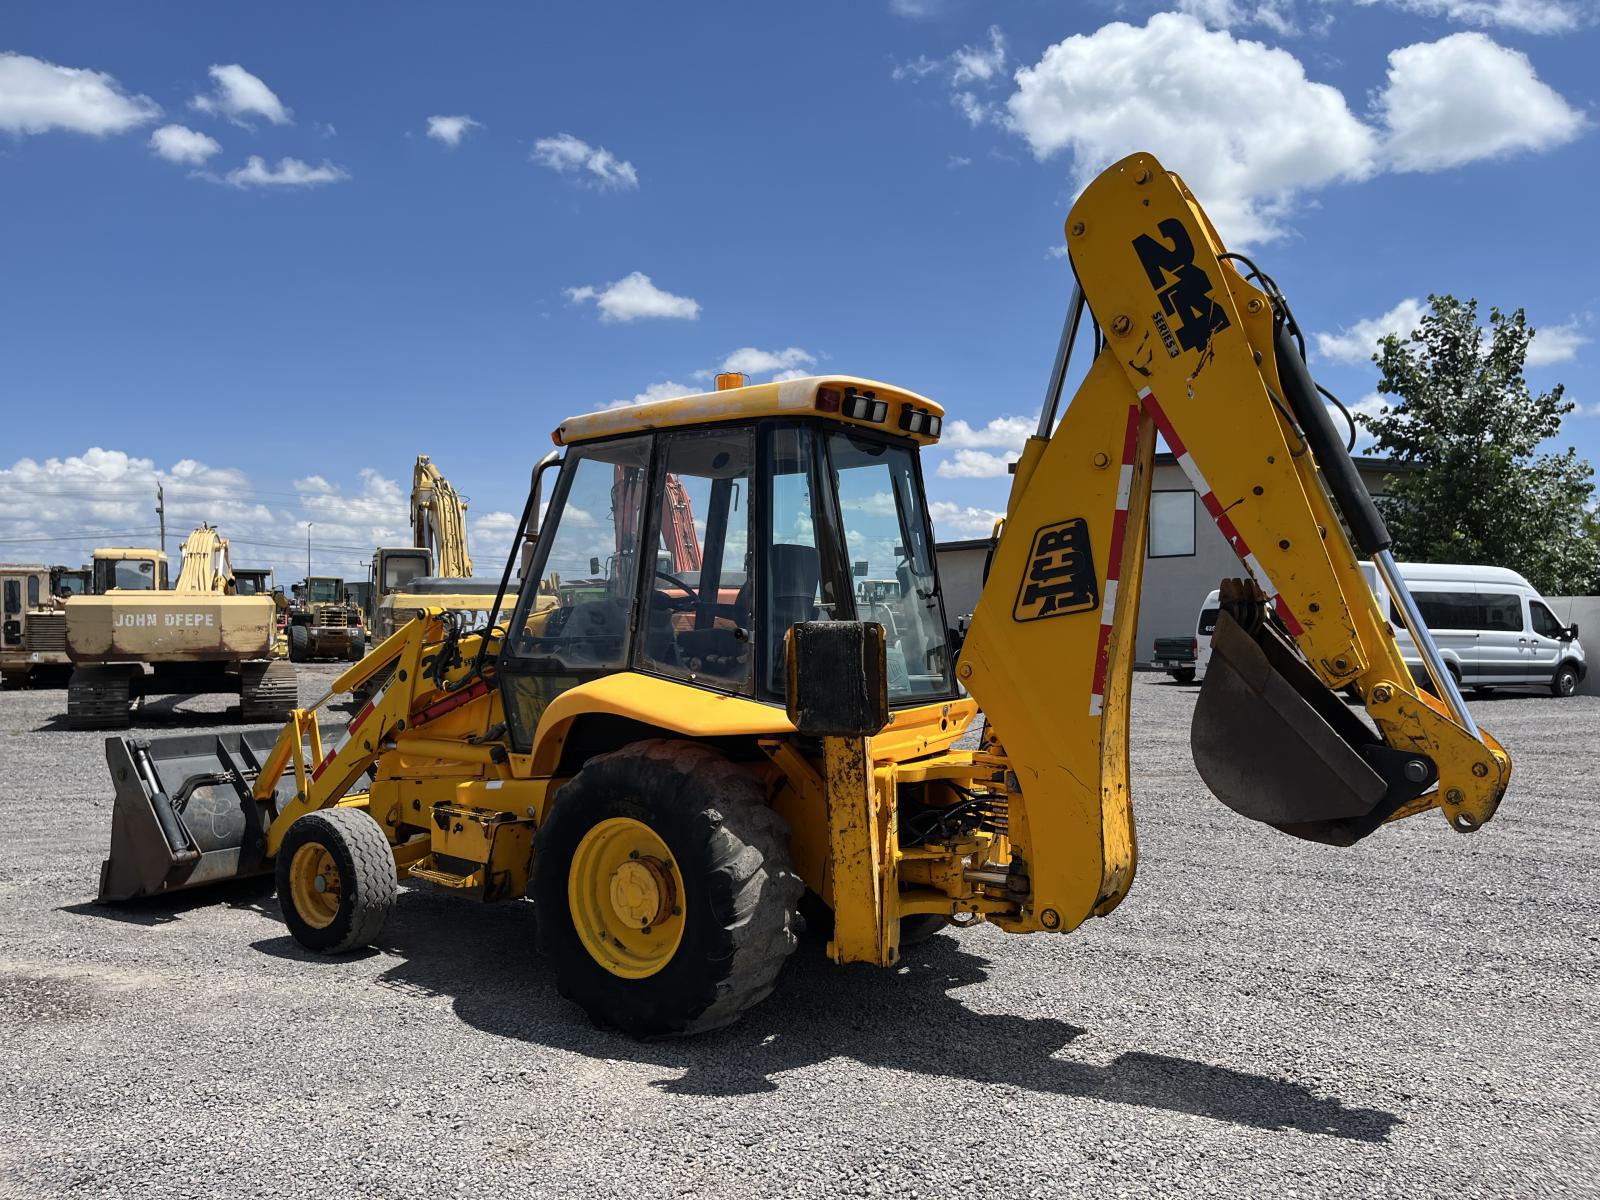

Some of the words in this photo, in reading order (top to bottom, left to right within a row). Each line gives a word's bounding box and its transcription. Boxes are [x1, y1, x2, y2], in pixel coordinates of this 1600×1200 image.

[1131, 217, 1232, 353] 214
[1152, 310, 1176, 349] SERIES
[1170, 348, 1180, 359] 3
[1019, 521, 1093, 618] JCB
[115, 613, 157, 627] JOHN
